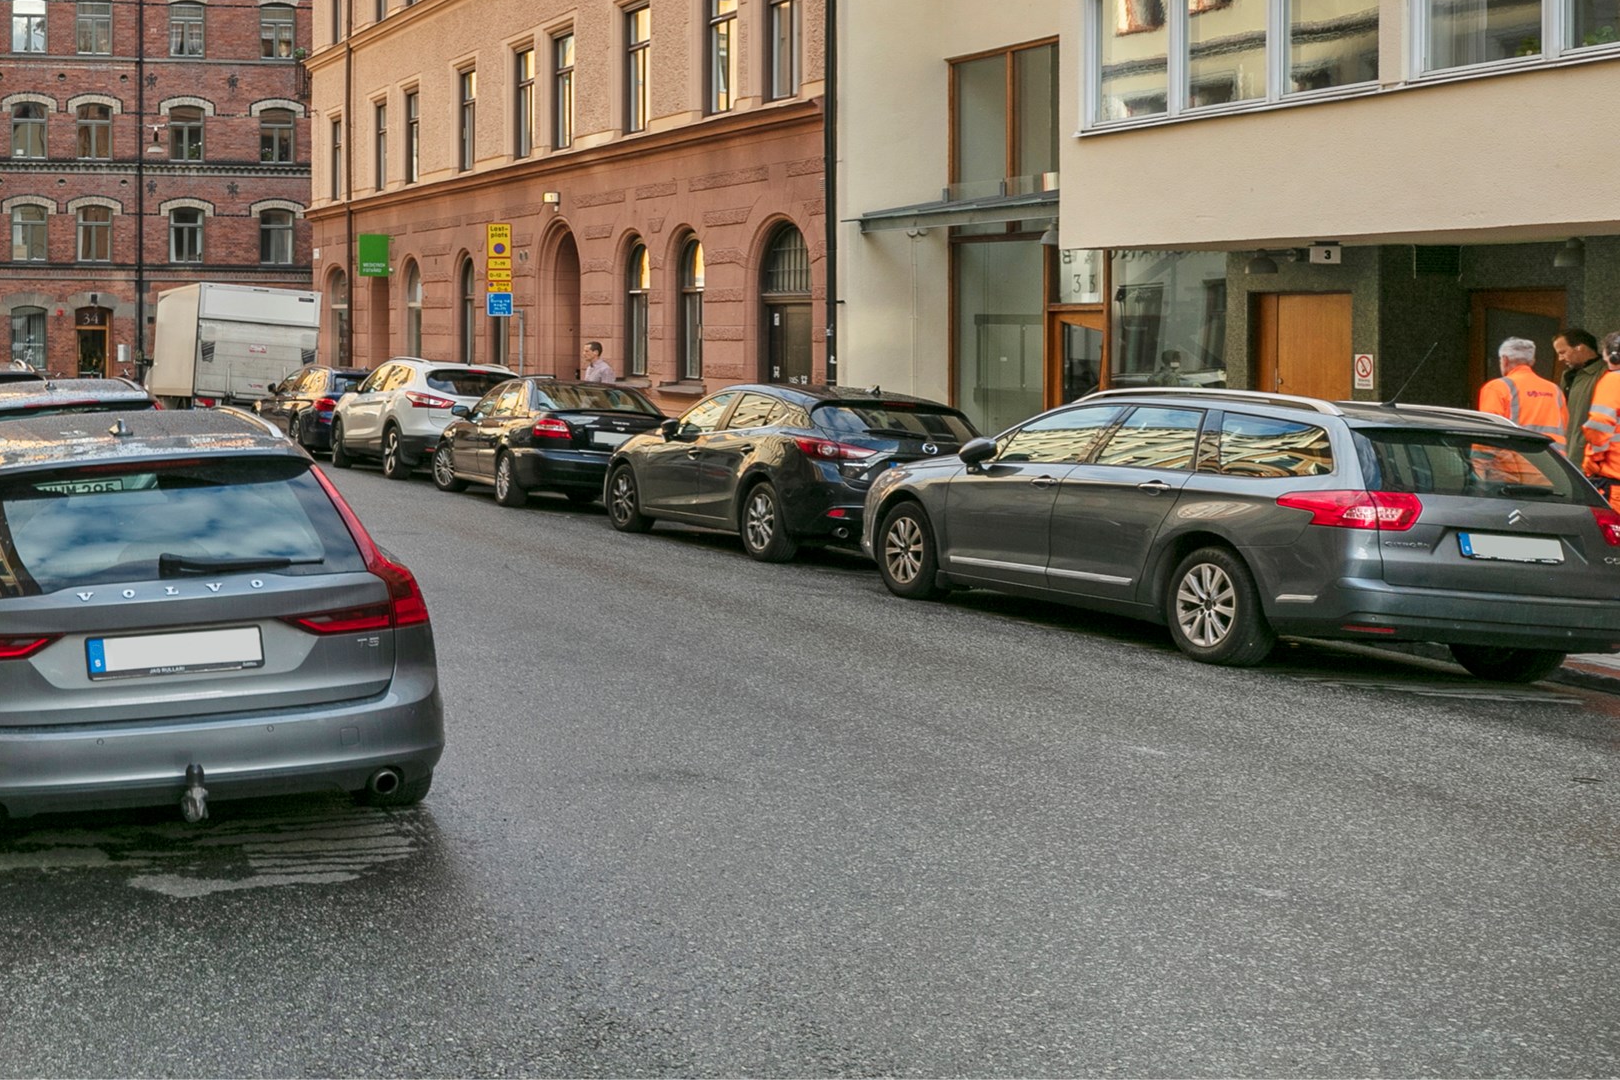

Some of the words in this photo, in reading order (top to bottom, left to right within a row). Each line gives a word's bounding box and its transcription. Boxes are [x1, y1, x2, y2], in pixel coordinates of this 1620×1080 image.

[1324, 249, 1332, 260] 3
[83, 312, 99, 325] 34
[77, 579, 265, 602] VOLVO
